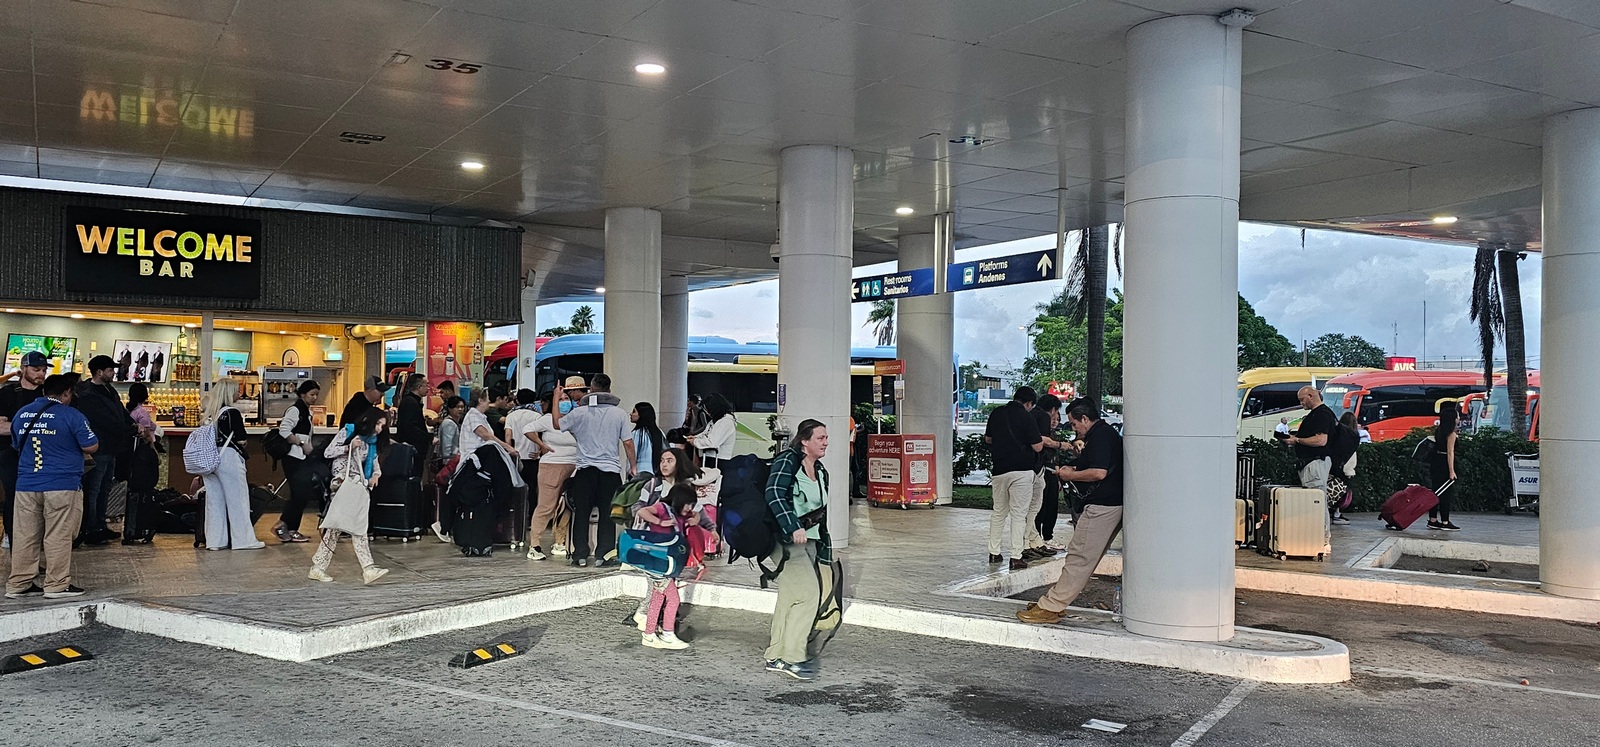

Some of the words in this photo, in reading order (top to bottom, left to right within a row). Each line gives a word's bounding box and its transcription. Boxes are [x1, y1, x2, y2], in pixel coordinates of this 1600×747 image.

[424, 59, 483, 75] 35
[75, 224, 252, 263] WELCOME
[139, 259, 194, 278] BAR
[978, 259, 1008, 273] Platforms
[883, 276, 896, 286] Rest
[896, 275, 912, 284] rooms
[978, 271, 1006, 284] Andenes
[883, 286, 909, 296] Sanitarios
[1393, 362, 1415, 371] AVIS
[874, 439, 885, 447] Begin
[1518, 476, 1538, 484] ASUR
